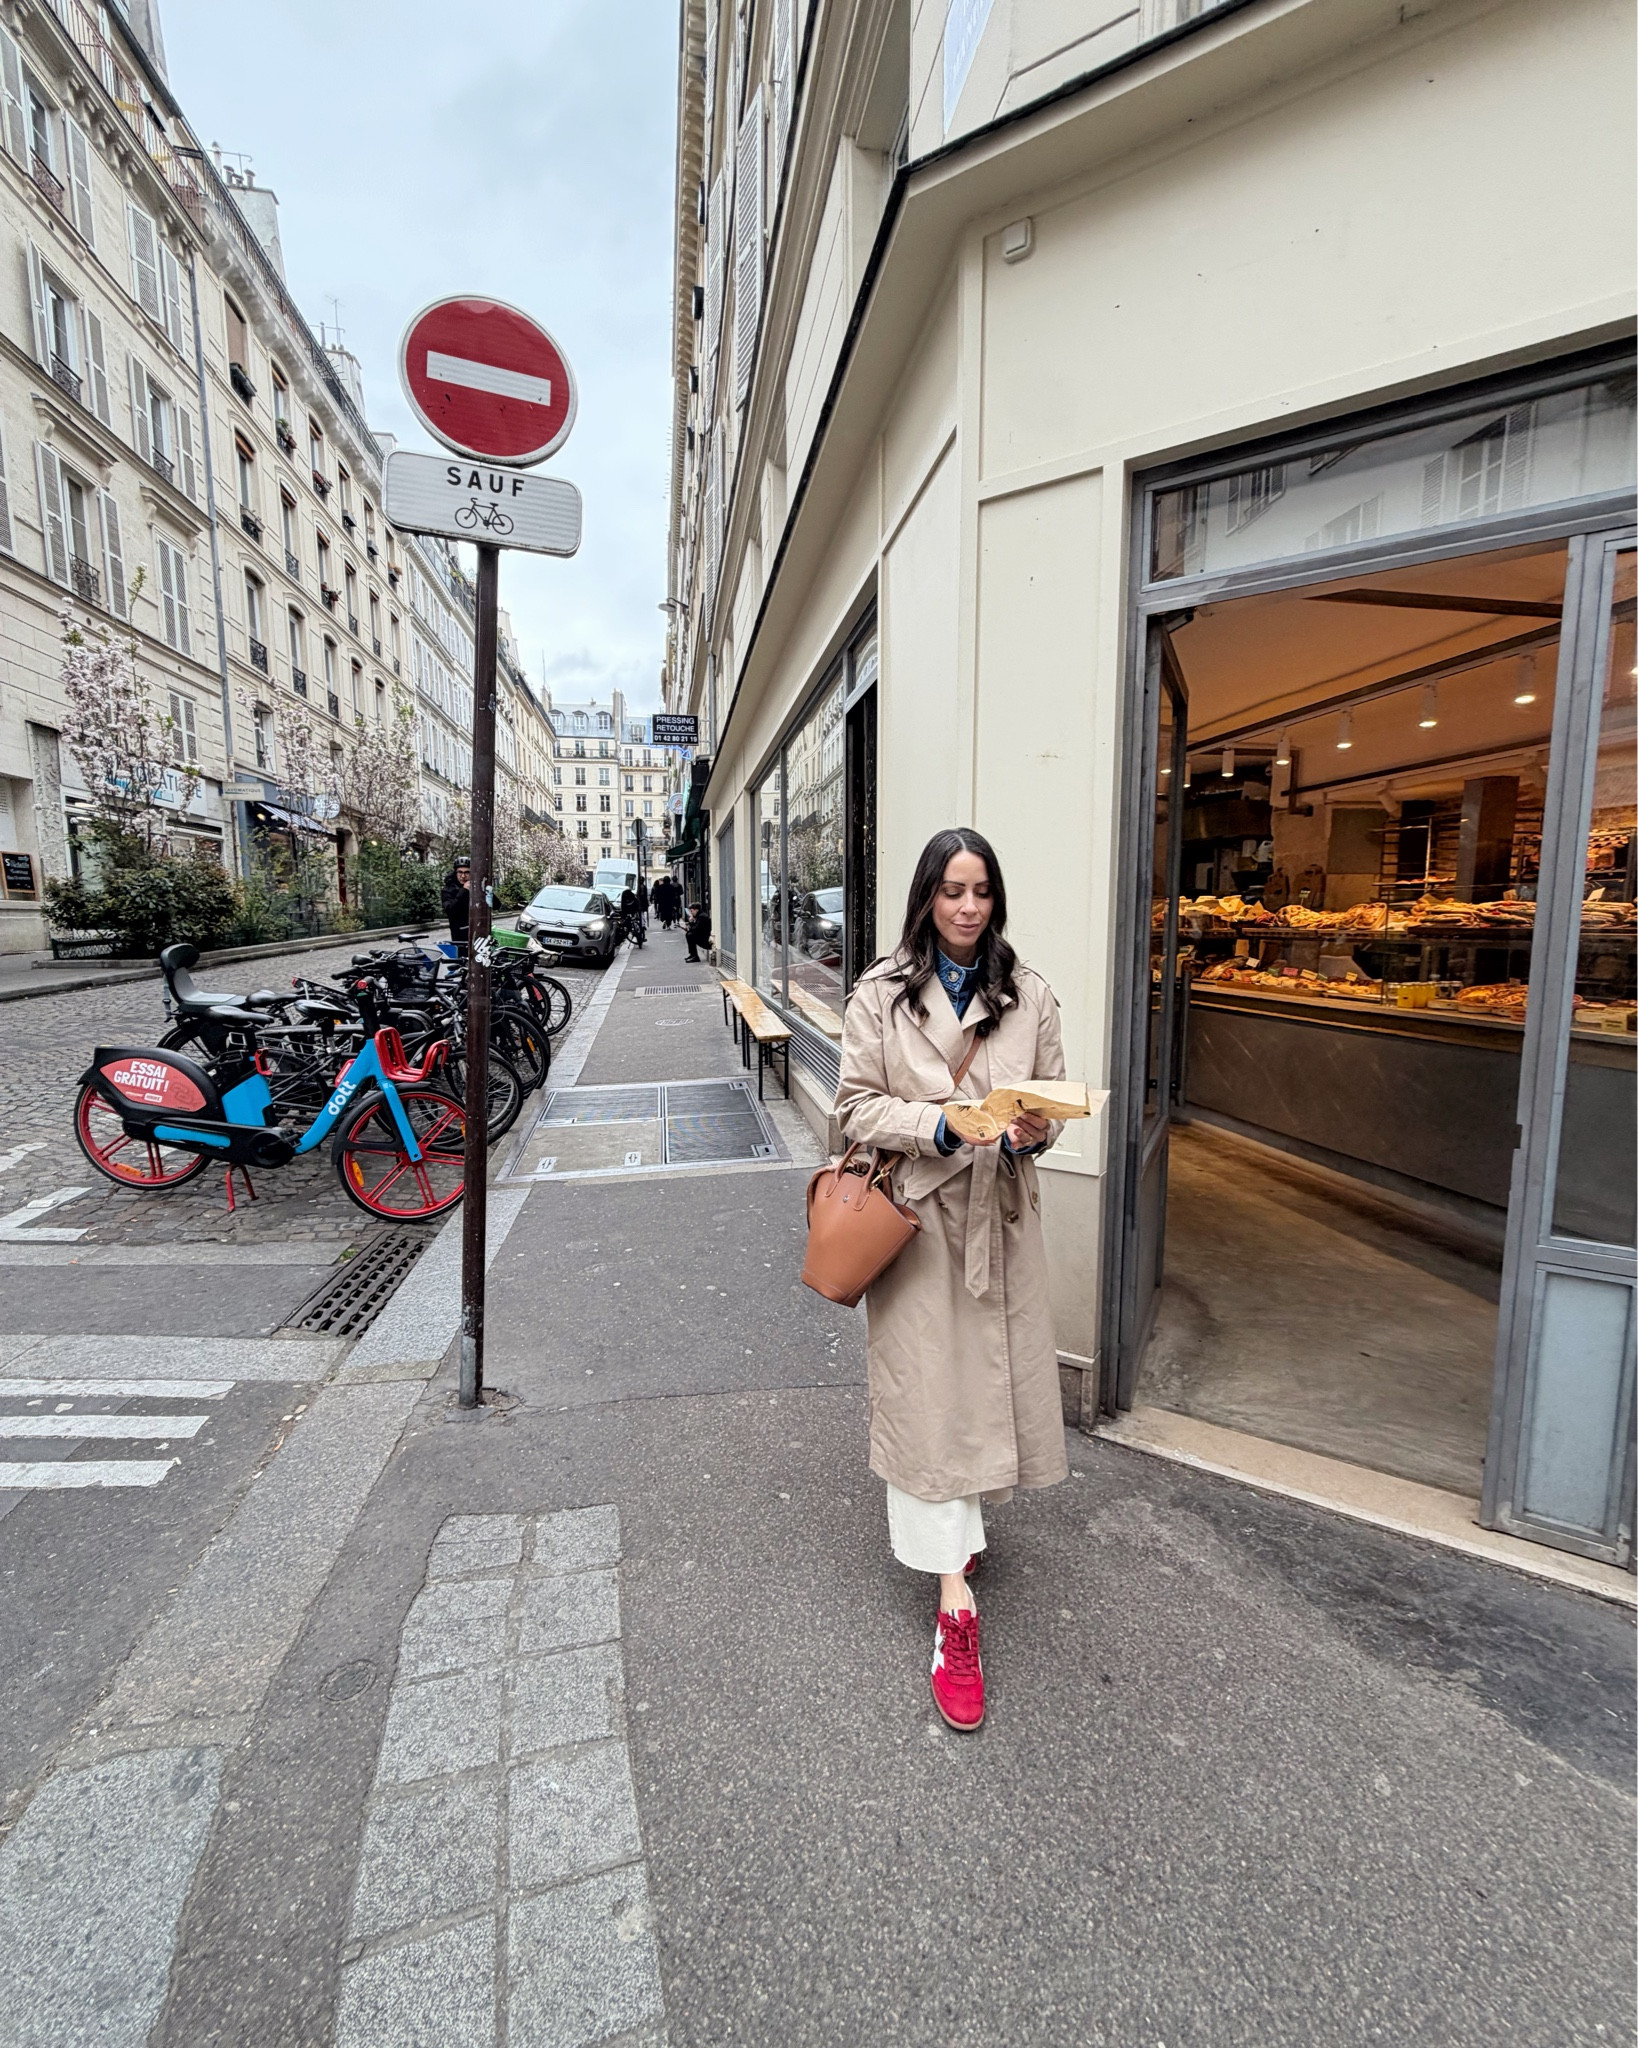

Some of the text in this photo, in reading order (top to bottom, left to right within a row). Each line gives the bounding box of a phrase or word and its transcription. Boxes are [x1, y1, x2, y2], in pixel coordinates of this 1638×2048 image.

[447, 467, 524, 496] SAUF
[656, 724, 695, 732] RETOUCHE
[130, 1060, 167, 1079] ESSAI
[328, 1081, 357, 1115] dott
